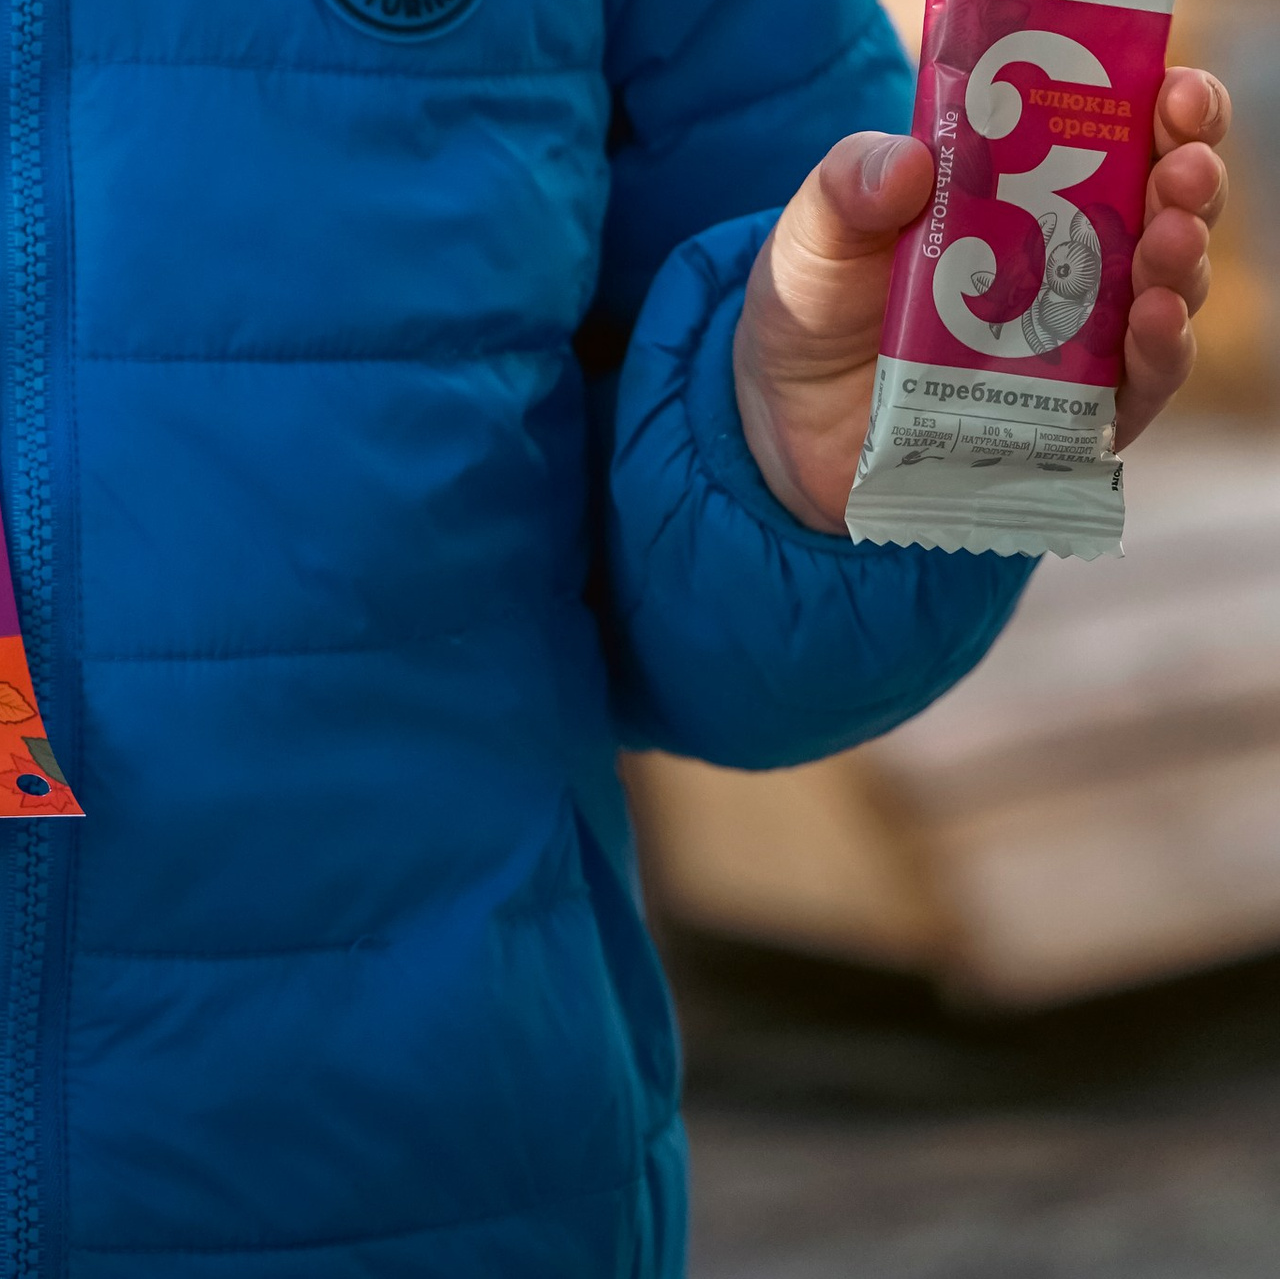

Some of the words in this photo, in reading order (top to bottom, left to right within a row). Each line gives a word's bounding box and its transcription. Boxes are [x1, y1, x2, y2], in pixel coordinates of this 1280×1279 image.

[1029, 86, 1132, 118] клюква
[1048, 113, 1131, 144] орехи
[922, 145, 955, 259] батончик
[902, 378, 918, 394] с
[924, 380, 1100, 418] пребиотиком
[912, 416, 937, 429] БЕЗ
[890, 426, 954, 441] ДОБАВЛЕНИЯ
[982, 424, 1001, 437] 100
[1003, 427, 1014, 439] %
[1039, 431, 1073, 445] МОЖНО
[892, 436, 946, 449] САХАРА
[961, 434, 1031, 452] НАТУРАЛЬНЫЙ
[1043, 443, 1094, 455] ПОДХОДИТ
[1033, 451, 1097, 465] ВЕГАНАМ
